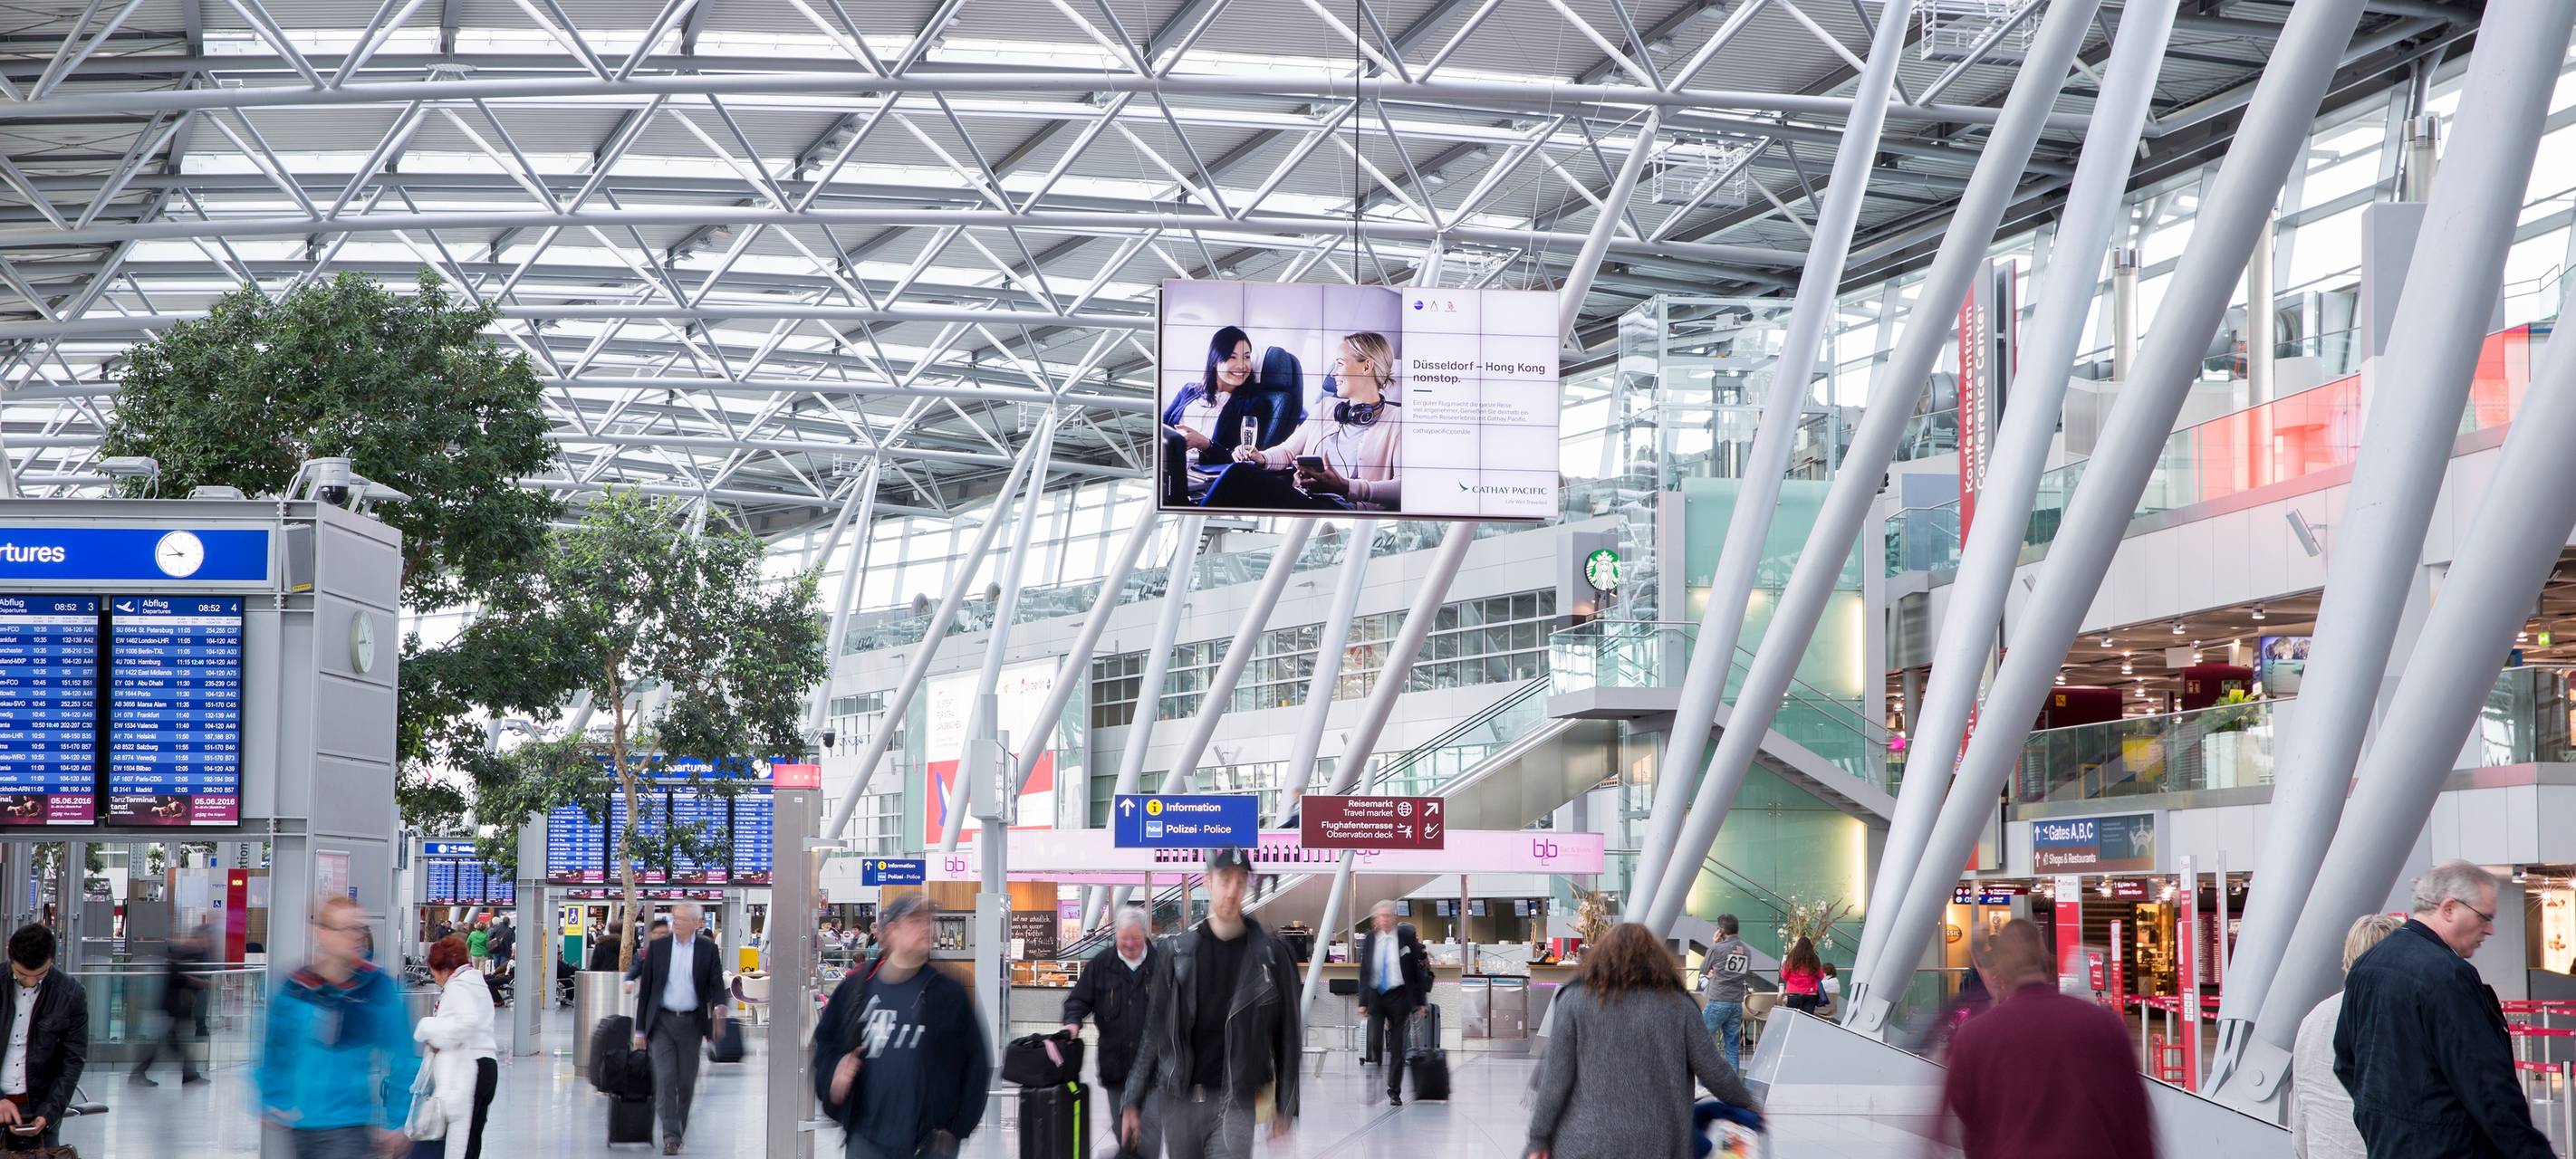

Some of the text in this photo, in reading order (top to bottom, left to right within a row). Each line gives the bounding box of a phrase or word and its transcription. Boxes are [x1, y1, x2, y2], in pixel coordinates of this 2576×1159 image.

[1413, 359, 1474, 370] Düsseldorf
[1485, 362, 1514, 374] Hong
[1518, 363, 1545, 375] Kong
[1413, 374, 1461, 385] nonstop.
[1965, 305, 1973, 493] Konferenzzentrum
[1976, 303, 1985, 491] Conference Center
[1472, 486, 1548, 495] CATHAY PACIFIC
[54, 603, 94, 611] 08:52 3
[142, 599, 168, 608] Abflug
[198, 604, 237, 612] 08:52 4
[136, 743, 159, 752] Salzburg
[1167, 803, 1221, 812] Information
[1348, 800, 1393, 808] Reisemarkt
[1343, 809, 1393, 818] Travel market
[1167, 824, 1232, 834] Polizei Police
[1322, 821, 1393, 831] Flughafenterrasse
[1326, 830, 1393, 838] Observation deck
[2049, 824, 2070, 841] Gates
[2071, 822, 2093, 842] A,B,C
[2049, 853, 2096, 867] Shops & Restaurants
[1728, 956, 1746, 972] 67
